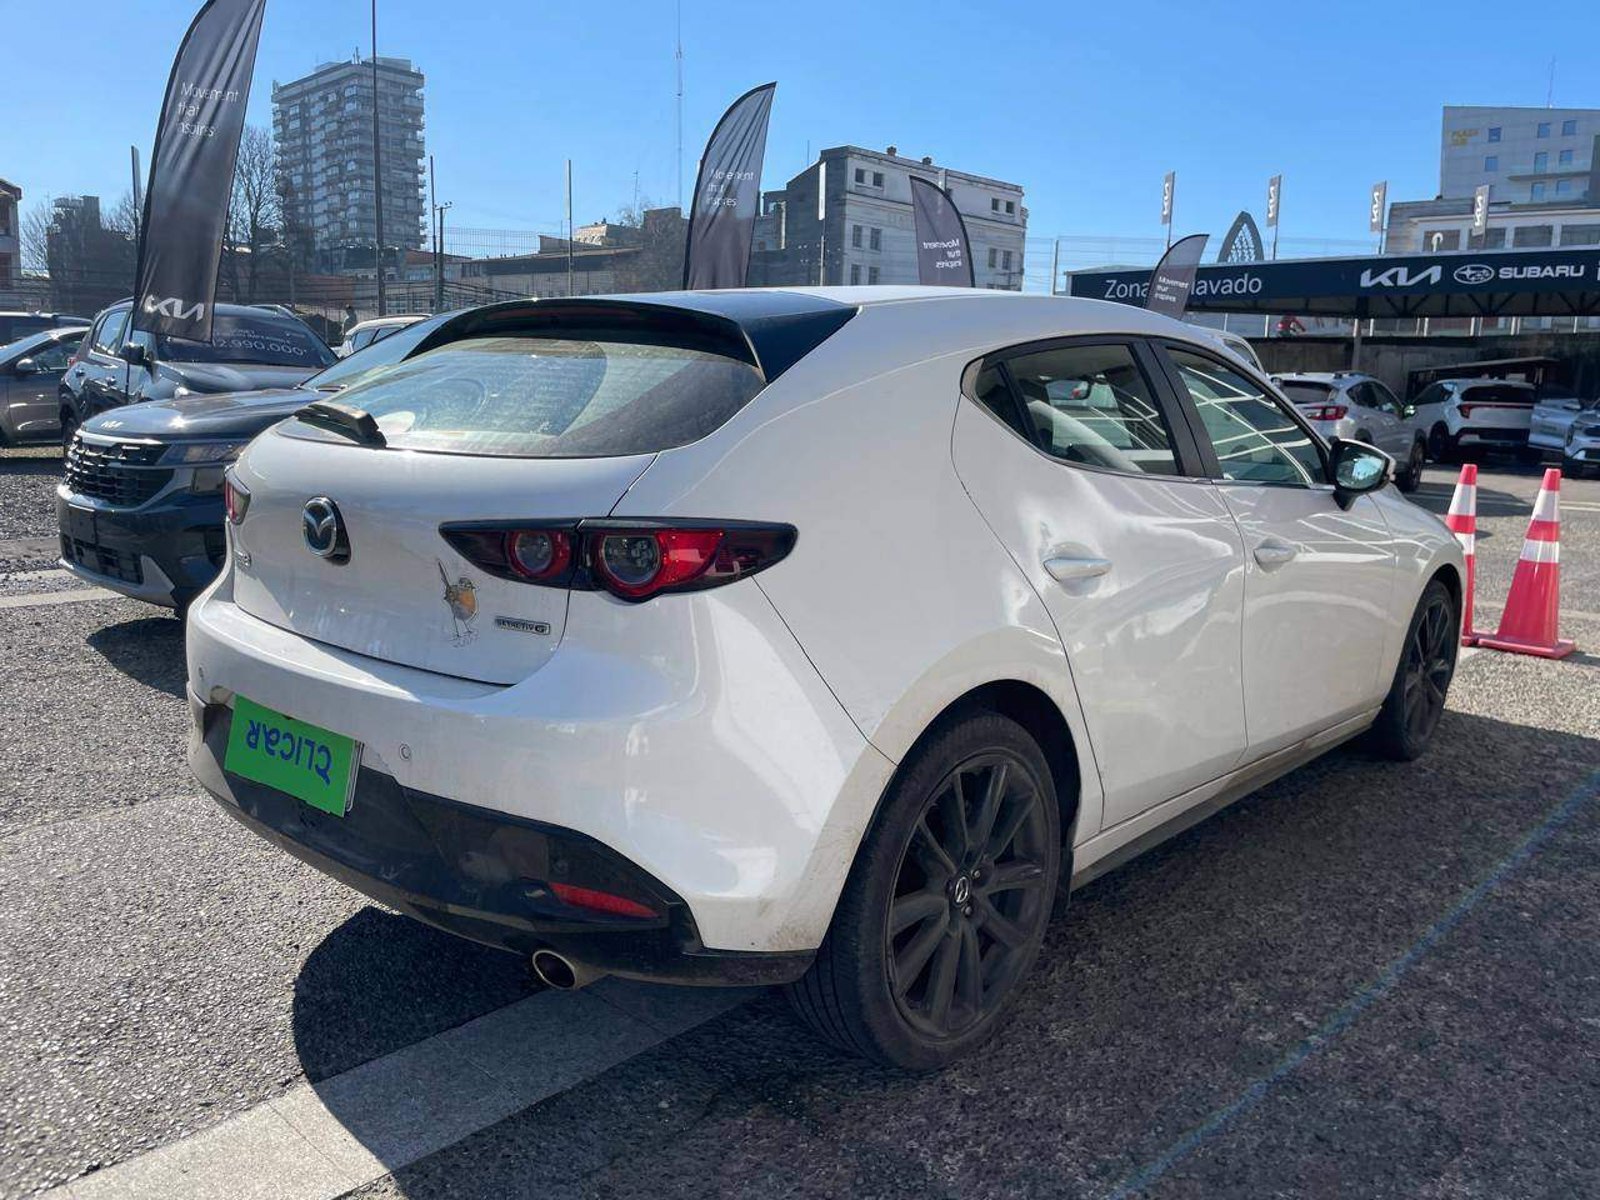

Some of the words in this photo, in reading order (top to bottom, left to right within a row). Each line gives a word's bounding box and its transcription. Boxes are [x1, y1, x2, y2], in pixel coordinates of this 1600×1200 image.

[180, 82, 239, 102] Movement
[178, 101, 200, 116] that
[1360, 265, 1442, 288] KIA
[1499, 265, 1585, 279] SUBARU
[1104, 279, 1149, 299] Zona
[1190, 273, 1262, 295] lavado
[144, 294, 204, 321] KIA
